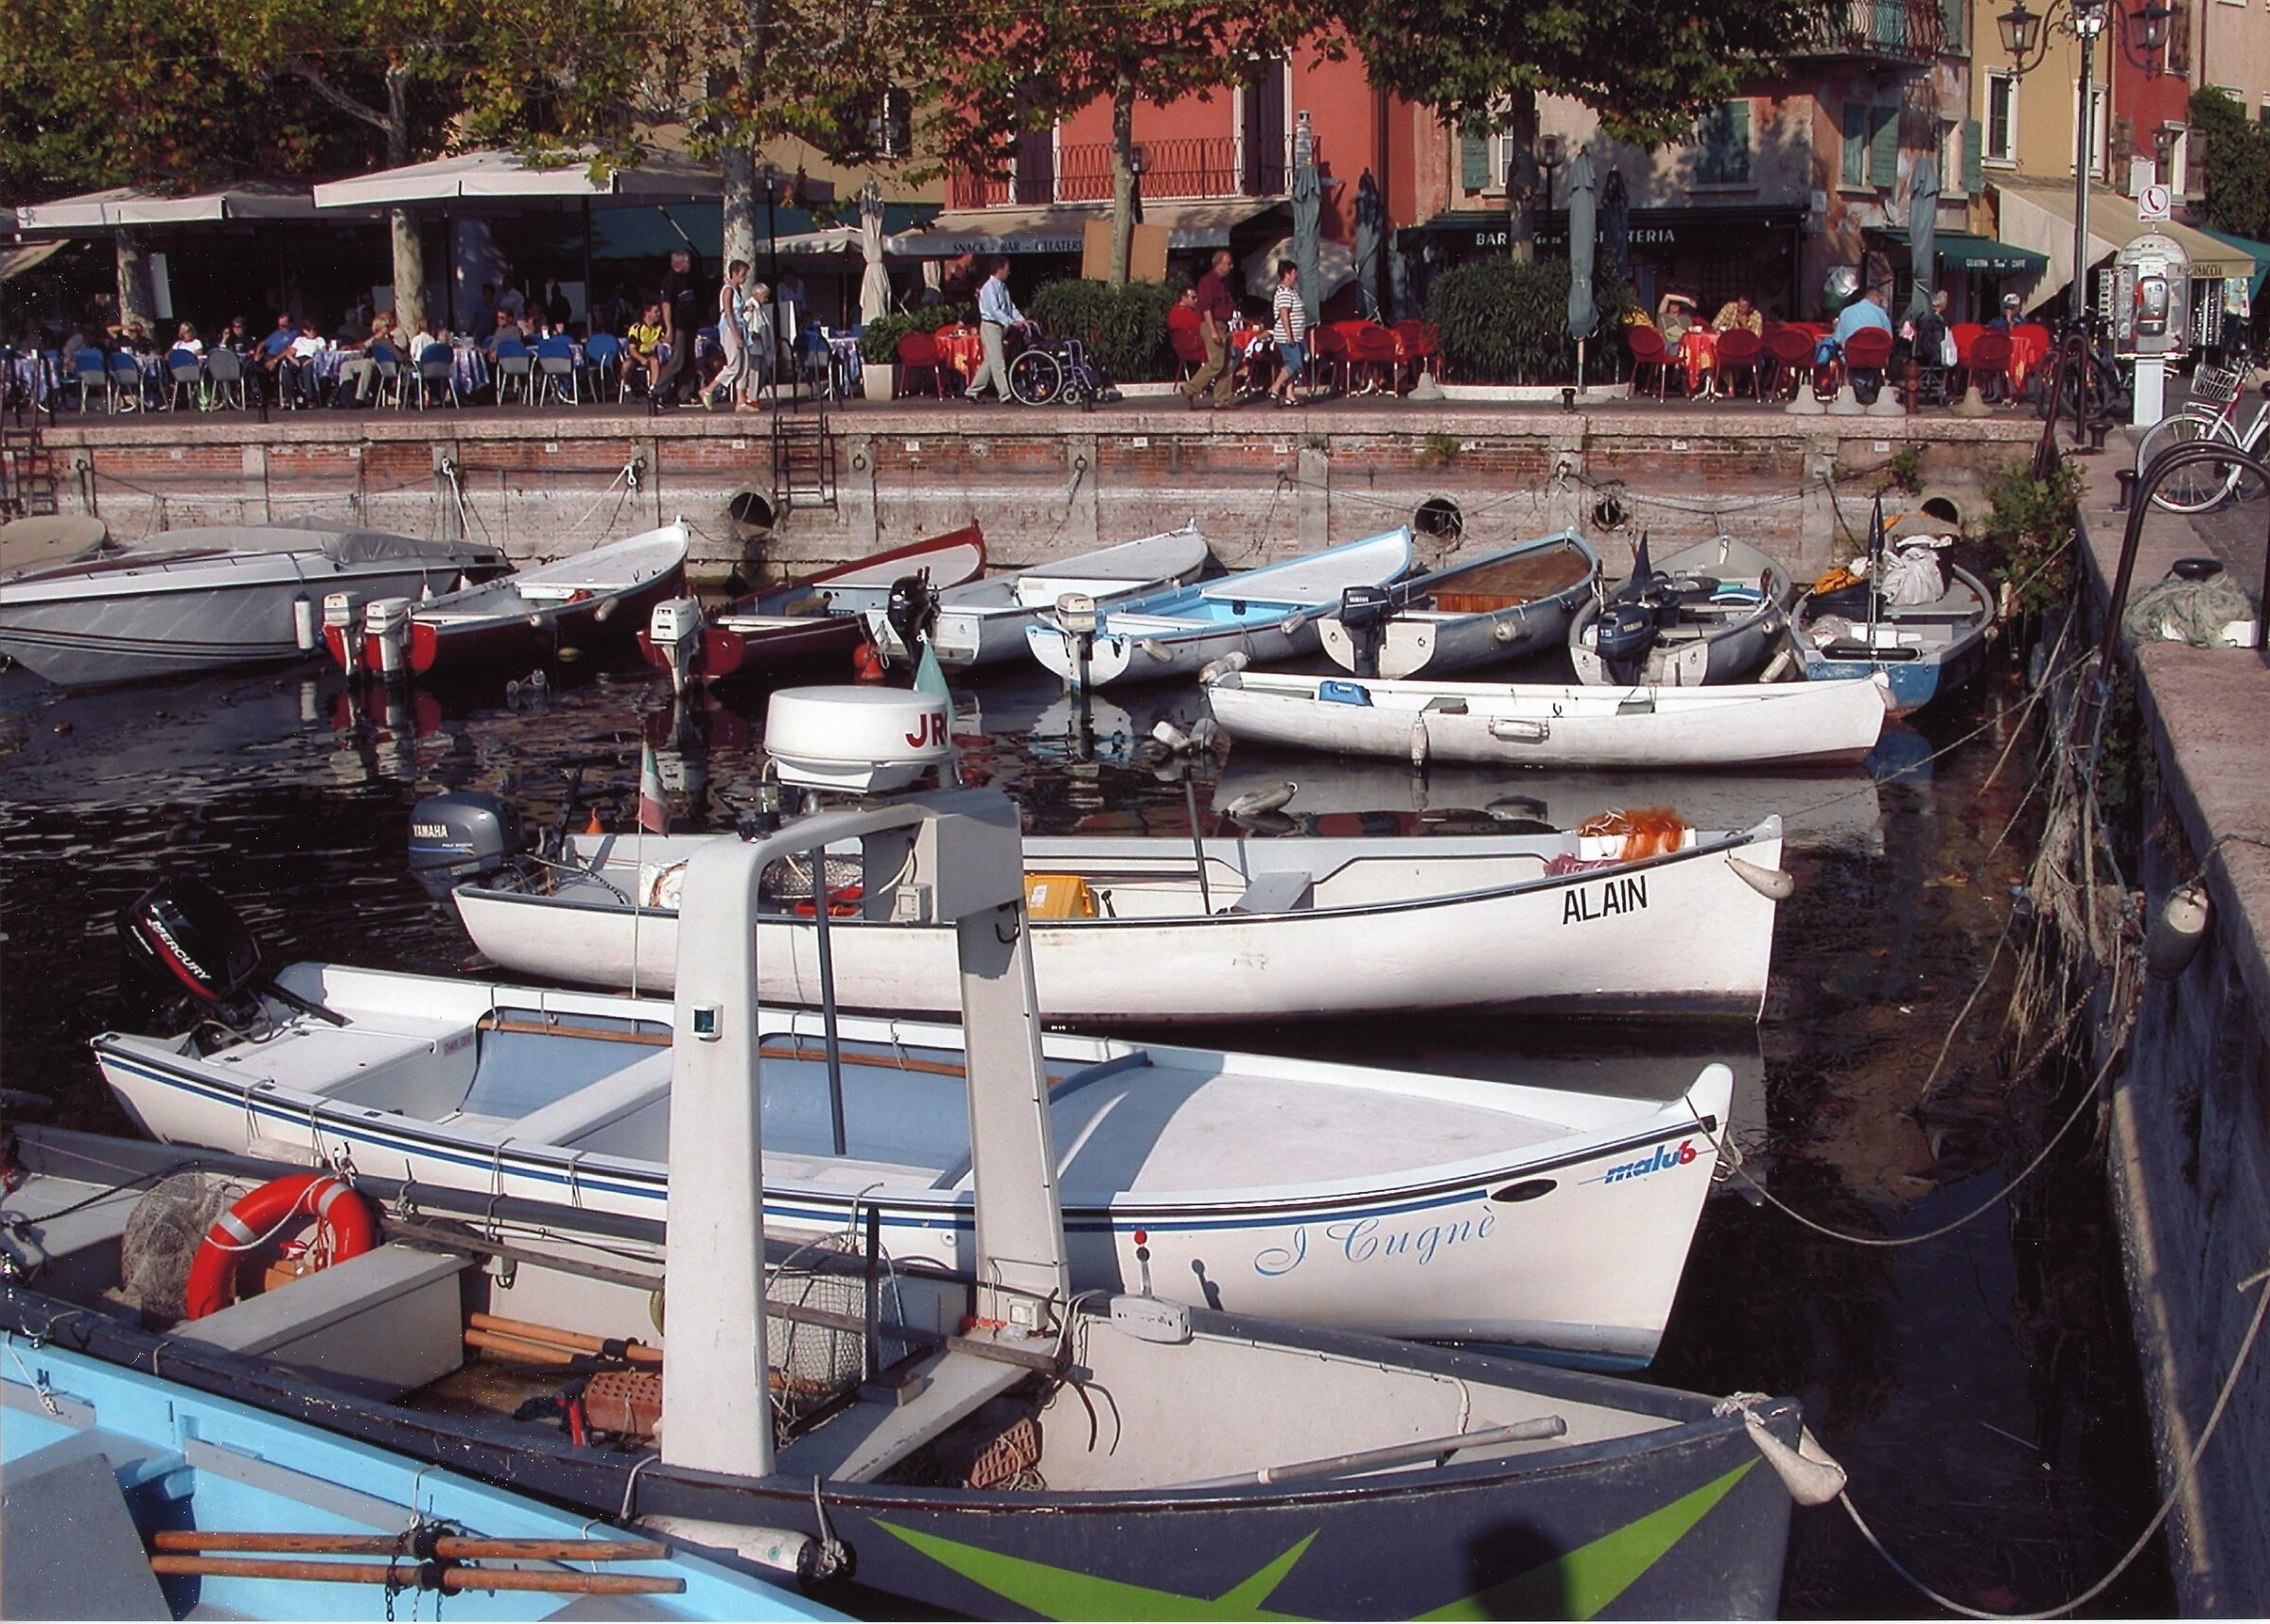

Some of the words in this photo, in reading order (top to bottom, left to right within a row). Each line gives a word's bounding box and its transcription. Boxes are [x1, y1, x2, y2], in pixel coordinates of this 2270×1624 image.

[952, 242, 986, 254] SNACK
[1000, 241, 1021, 253] BAR
[1476, 232, 1508, 246] BAR
[412, 824, 448, 838] YAMAHA
[1563, 875, 1648, 925] ALAIN
[146, 917, 212, 979] MERCURY
[1326, 1205, 1496, 1266] Cugnè
